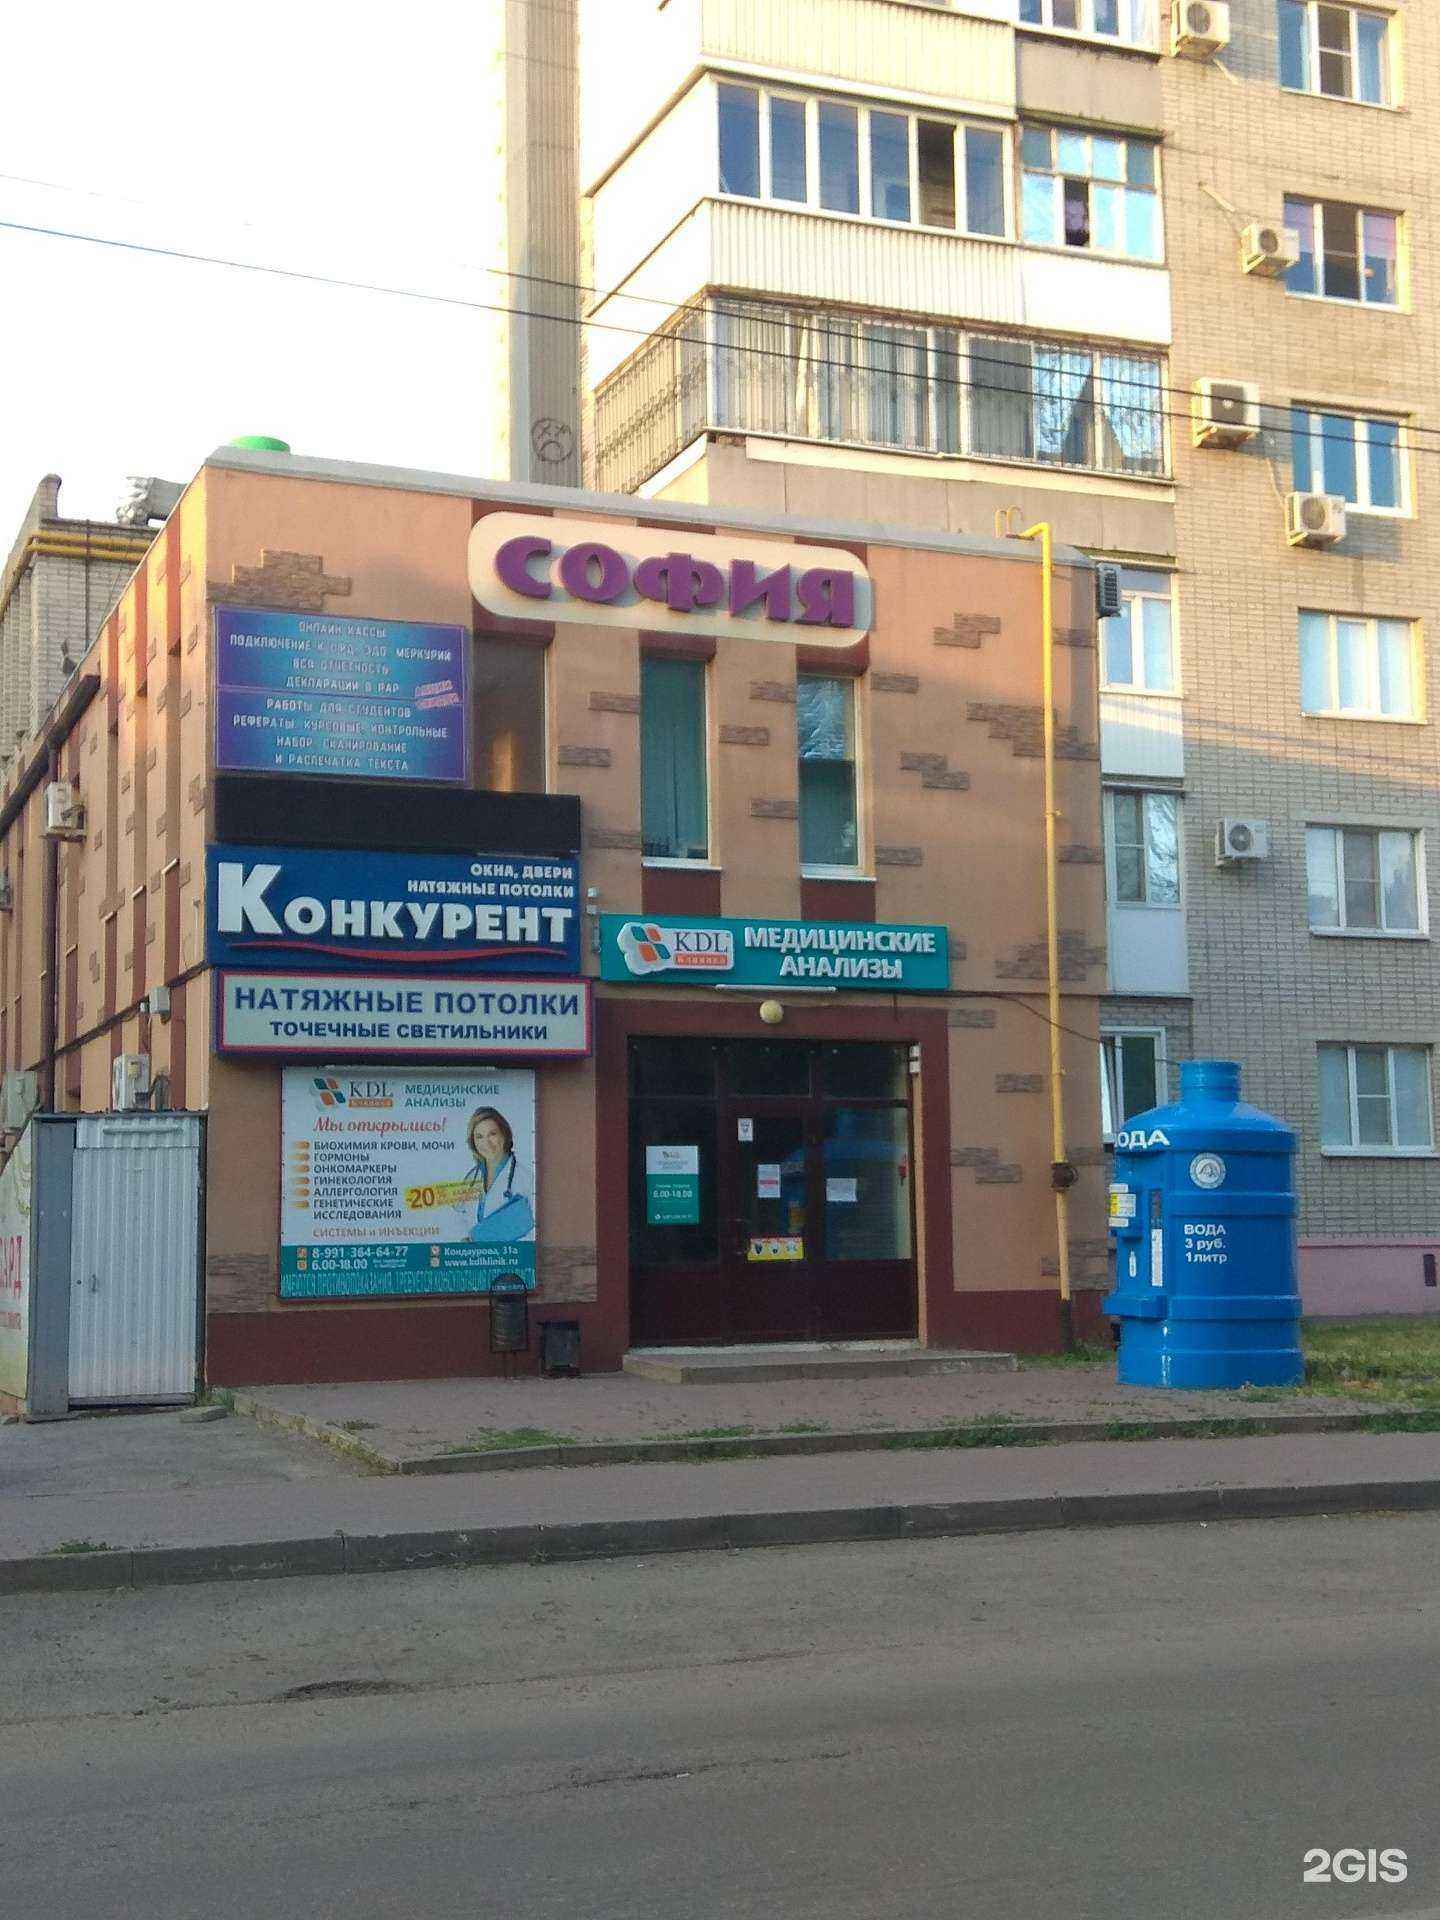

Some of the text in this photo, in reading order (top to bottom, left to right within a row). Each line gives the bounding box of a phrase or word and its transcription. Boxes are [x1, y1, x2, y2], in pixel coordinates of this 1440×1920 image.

[495, 535, 854, 628] СОФИЯ
[347, 625, 386, 637] КАССЫ
[230, 633, 311, 651] ПОДКЛЮЧЕНИЕ
[293, 658, 389, 674] ВСЯ ОТЧЕТНОСТЬ
[286, 676, 358, 691] ДЕКЛАРАЦИИ
[365, 681, 372, 692] В
[266, 698, 411, 718] РАБОТЫ ДЛЯ СТУДЕНТОВ
[372, 723, 448, 738] КОНТРОЛЬНЫЕ
[323, 738, 407, 753] СКАНИРОВАНИЕ
[275, 753, 408, 770] И РАСПЕЧАТКА ТЕКСТА
[470, 863, 573, 880] ОКНА, ДВЕРИ
[407, 880, 574, 898] НАТЯЖНЫЕ ПОТОЛКИ
[673, 932, 728, 952] KDL
[744, 927, 937, 953] МЕДИЦИНСКИЕ
[779, 956, 903, 979] АНАЛИЗЫ
[235, 987, 578, 1015] НАТЯЖНЫЕ ПОТОЛКИ
[270, 1021, 548, 1040] ТОЧЕЧНЫЕ СВЕТИЛЬНИКИ
[350, 1081, 393, 1097] KDL
[405, 1084, 500, 1097] МЕДИЦИНСКИЕ
[404, 1097, 466, 1107] АНАЛИЗЫ
[313, 1116, 447, 1137] Мы открылись!
[313, 1141, 455, 1152] БИОХИМИЯ КРОВИ, МОЧИ
[1115, 1129, 1170, 1149] ОДА
[313, 1153, 370, 1161] ГОРМОНЫ
[313, 1164, 397, 1174] ОНКОМАРКЕРЫ
[313, 1176, 392, 1185] ГИНЕКОЛОГИЯ
[313, 1187, 398, 1197] АЛЛЕРГОЛОГИЯ
[313, 1198, 394, 1208] ГЕНЕТИЧЕСКИЕ
[313, 1210, 402, 1220] ИССЛЕДОВАНИЯ
[313, 1227, 366, 1237] СИСТЕМЫ
[379, 1226, 440, 1237] ИНЪЕКЦИИ
[1184, 1224, 1226, 1236] ВОДА
[312, 1245, 409, 1258] 8-991 364-64-77
[1185, 1238, 1226, 1250] 3 руб.
